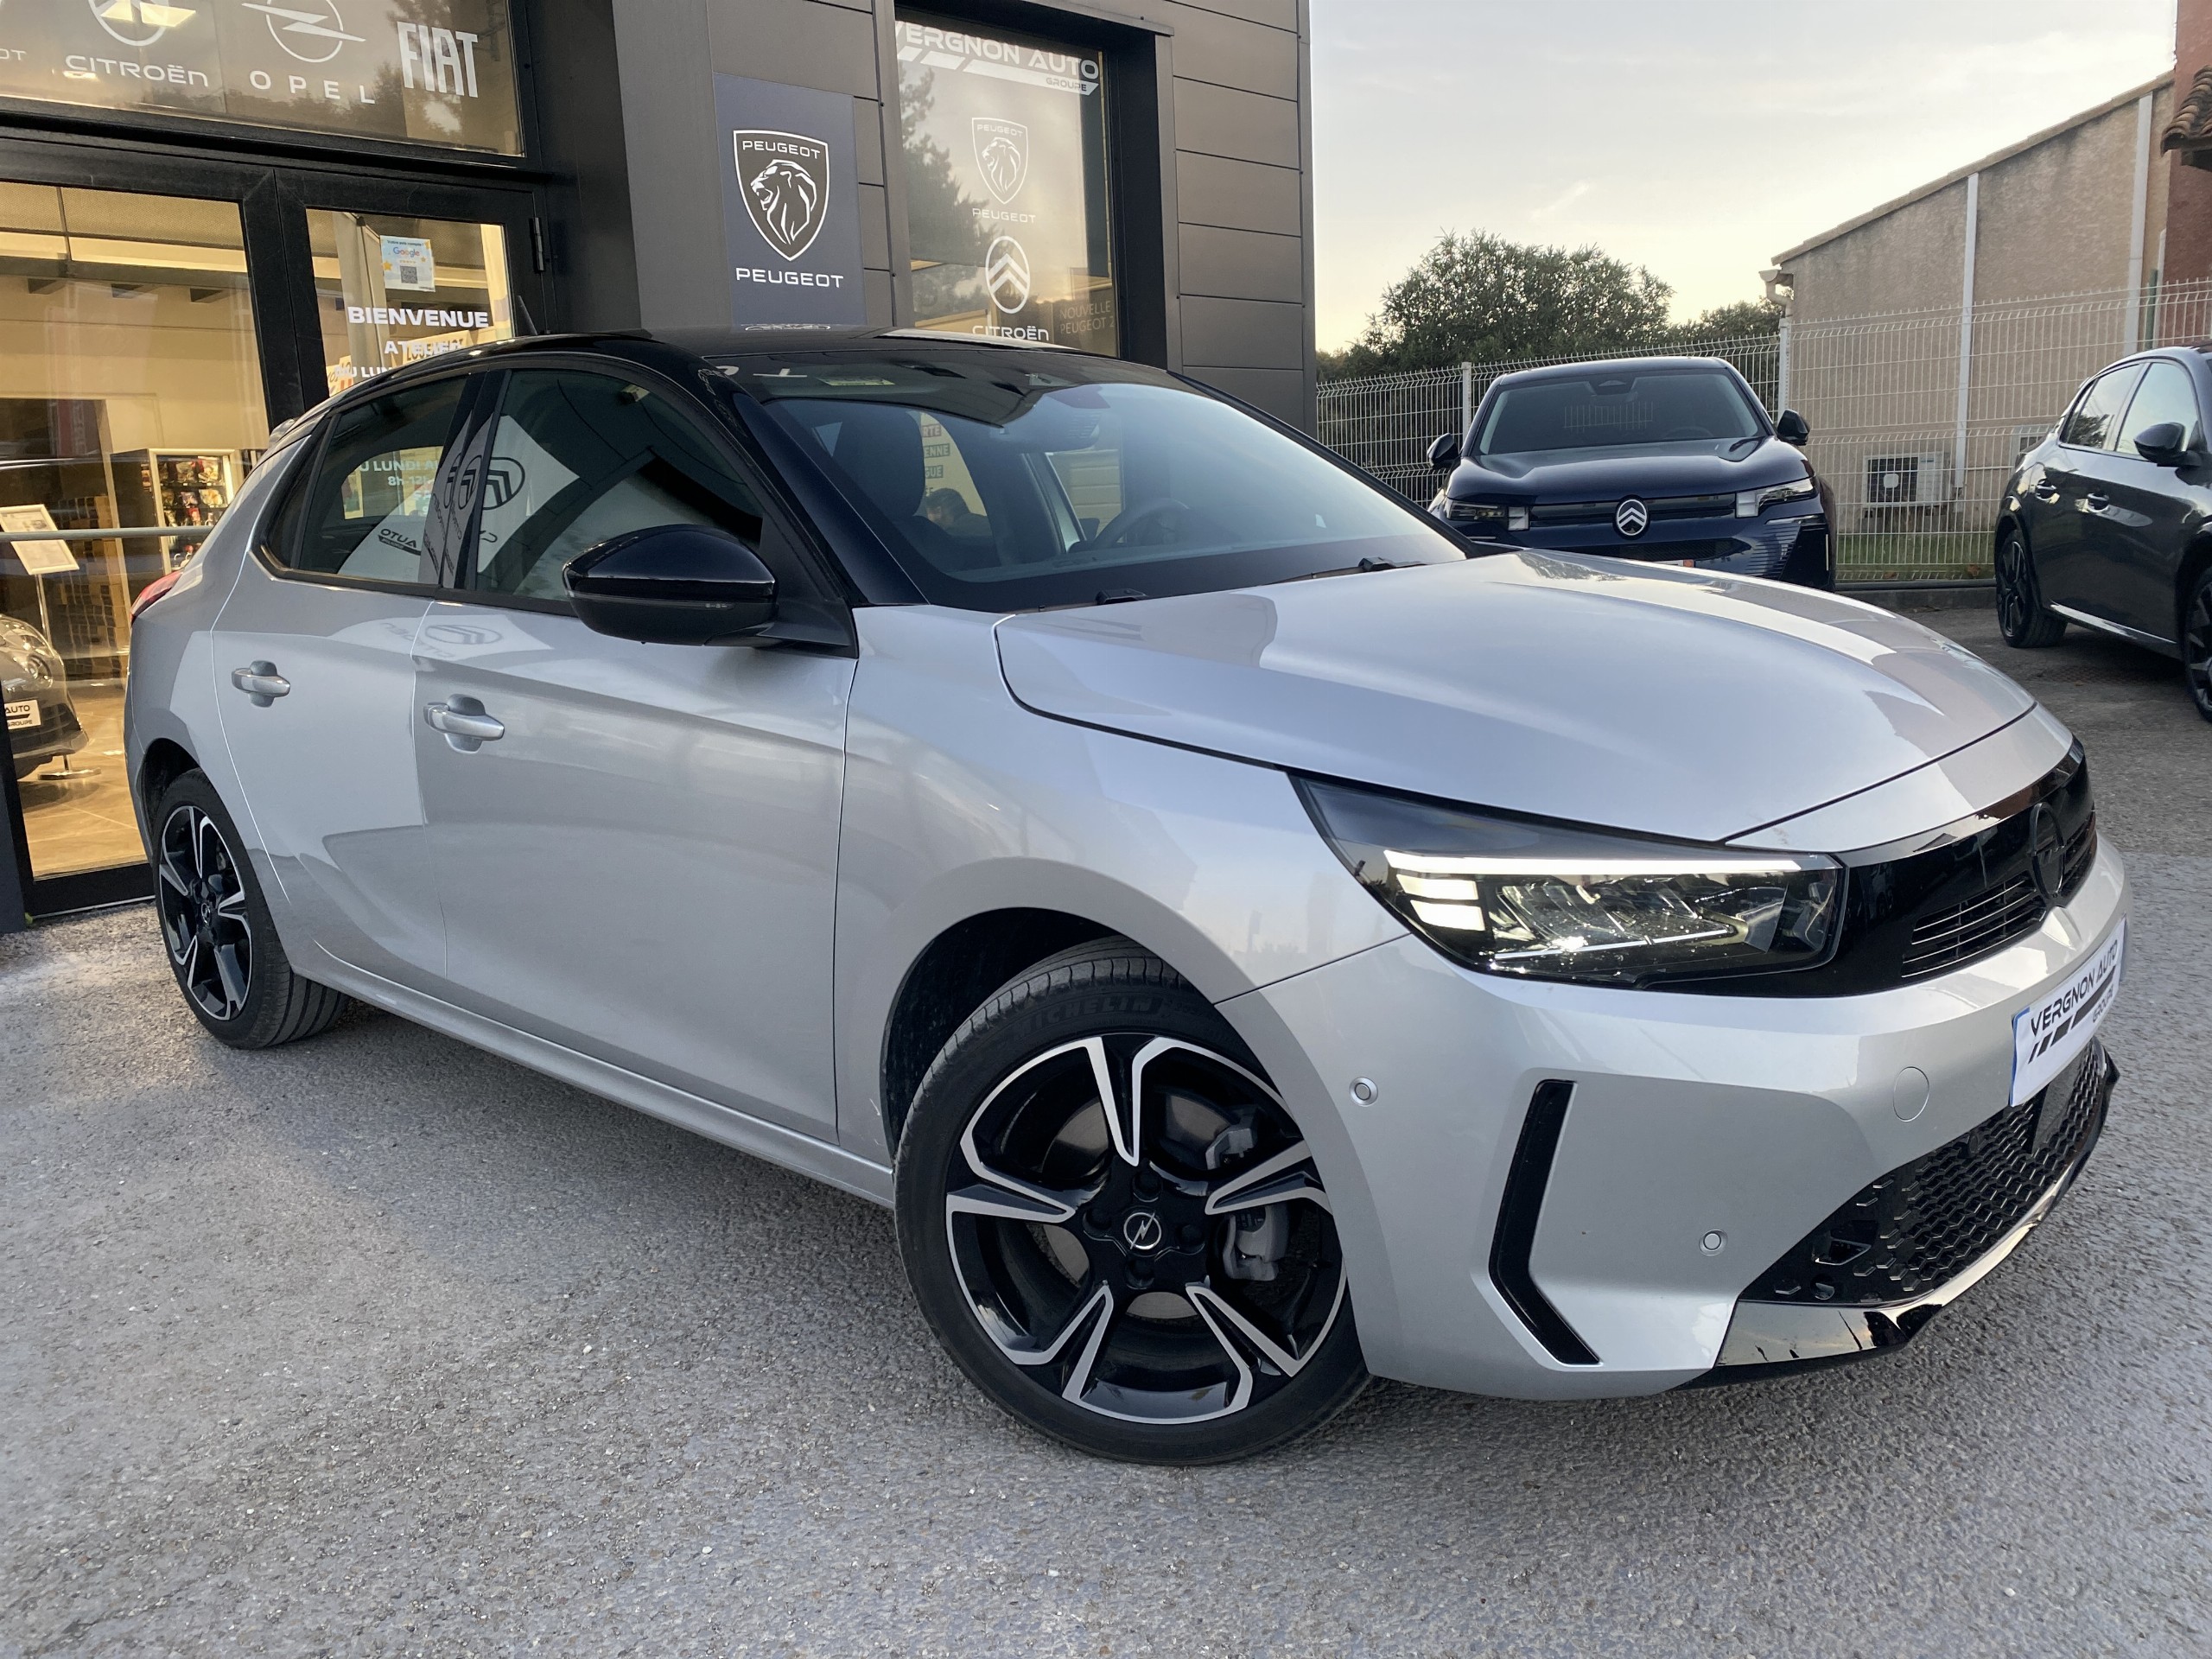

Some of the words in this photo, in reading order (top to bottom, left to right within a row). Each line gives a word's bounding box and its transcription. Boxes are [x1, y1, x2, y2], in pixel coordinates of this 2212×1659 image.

[397, 21, 479, 99] FIAT
[1028, 49, 1099, 79] AUTO
[249, 70, 376, 105] OPEL
[1046, 77, 1087, 92] GROUPE
[976, 124, 1024, 137] PEUGEOT
[742, 140, 821, 159] PEUGEOT
[972, 207, 1036, 224] PEUGEOT
[392, 246, 421, 258] Google
[736, 267, 844, 288] PEUGEOT
[347, 306, 489, 328] BIENVENUE
[1060, 301, 1111, 320] NOUVELLE
[1060, 317, 1107, 334] PEUGEOT
[373, 460, 421, 472] LUNDI
[5, 704, 30, 714] AUTO
[2031, 968, 2095, 1038] VERGNON
[2096, 938, 2118, 983] AUTO
[1009, 995, 1154, 1035] MICHELIN
